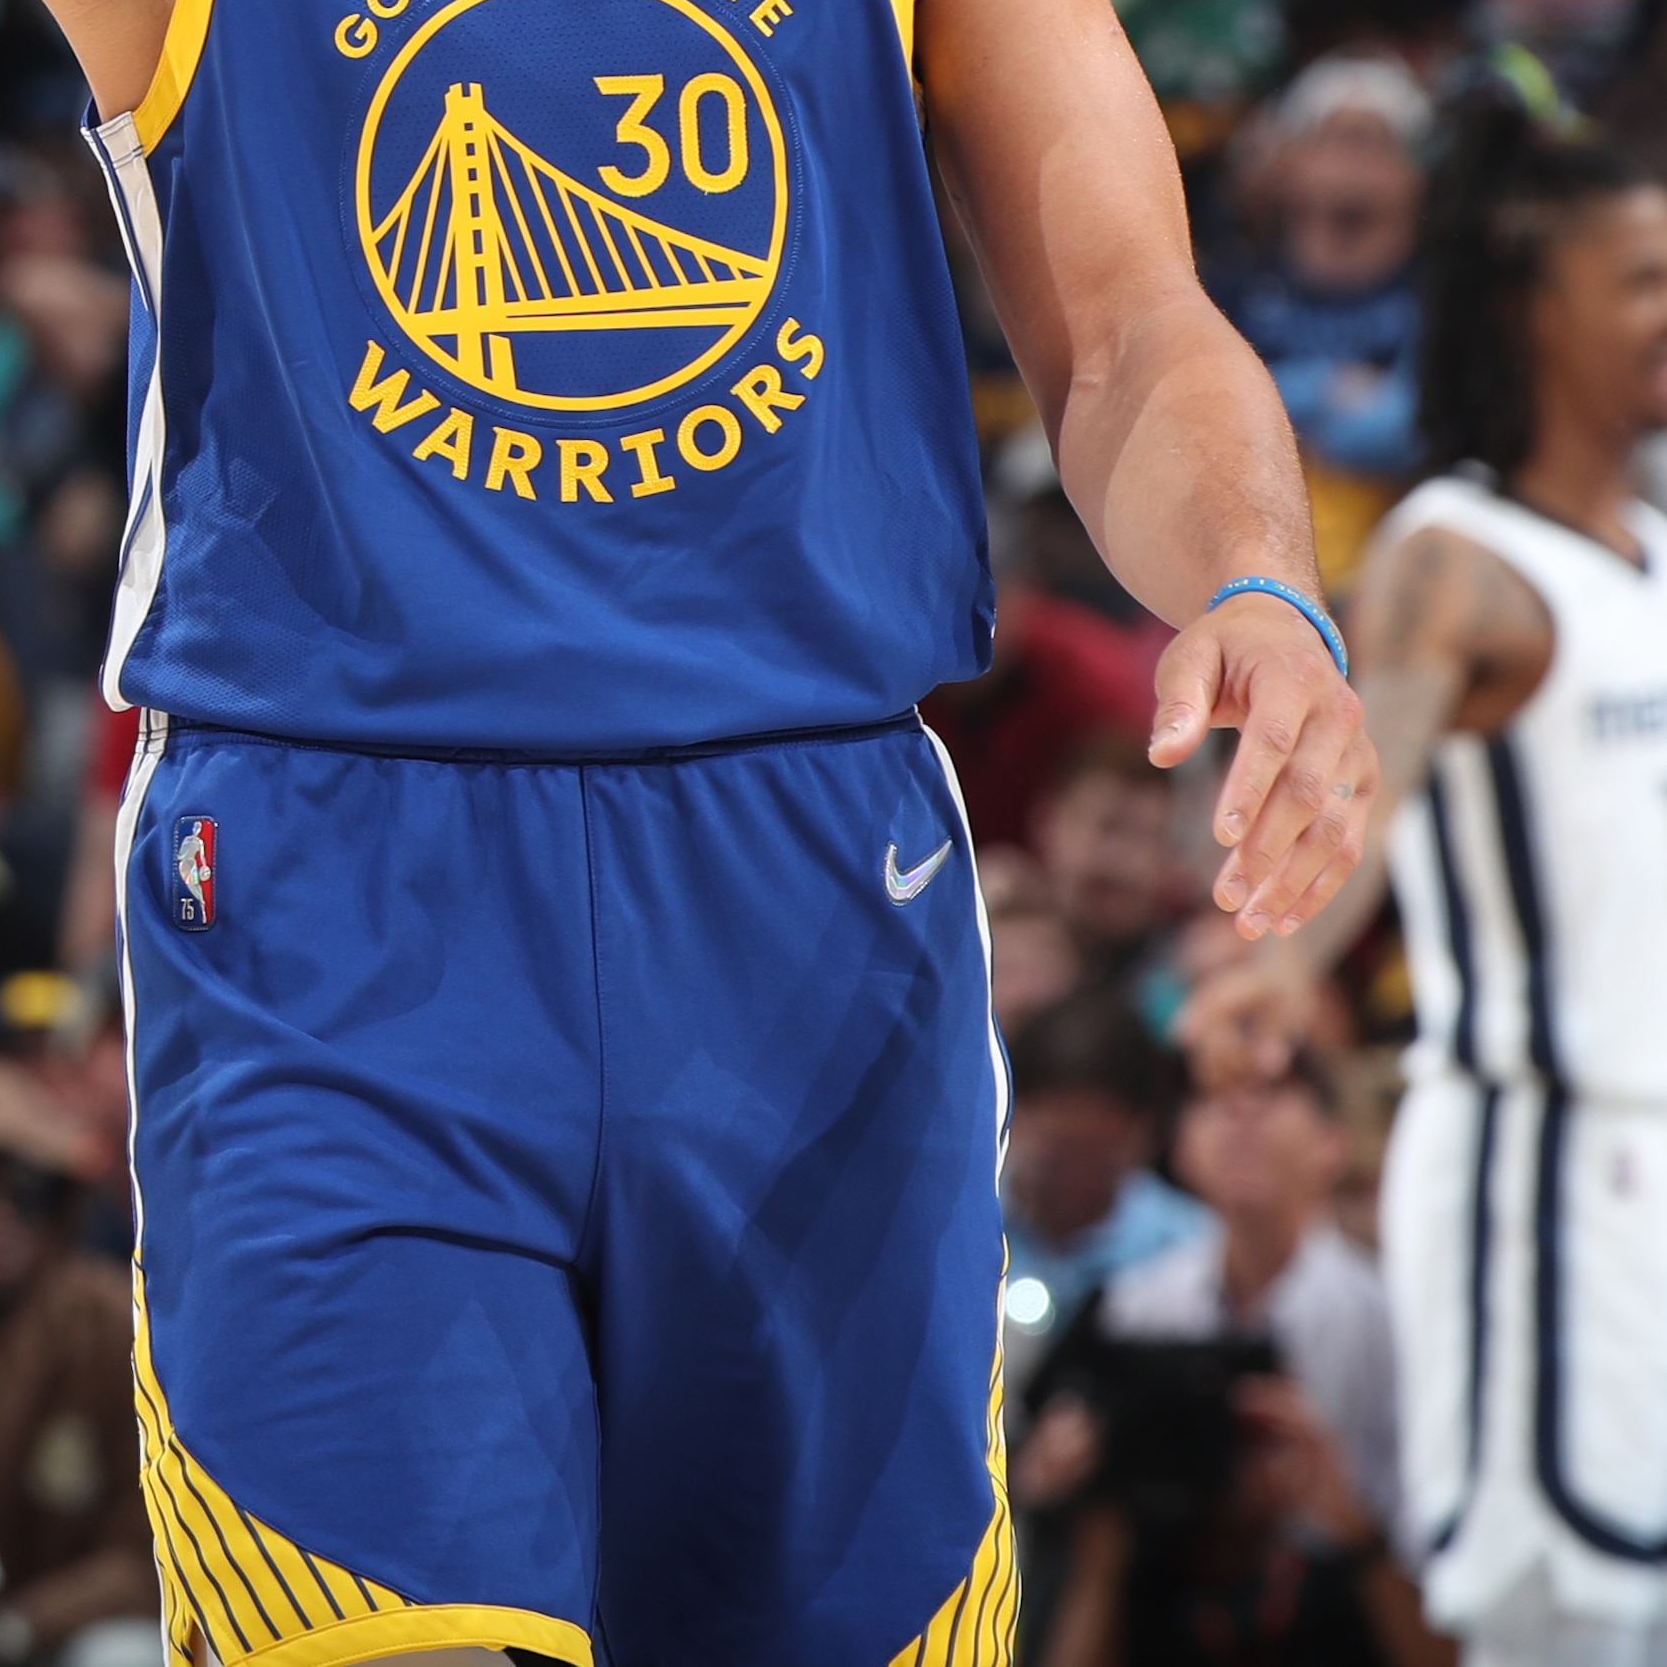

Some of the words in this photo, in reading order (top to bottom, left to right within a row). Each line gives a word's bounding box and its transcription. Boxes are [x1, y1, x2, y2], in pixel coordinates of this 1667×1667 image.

[594, 74, 748, 197] 30
[348, 318, 824, 505] WARRIORS
[181, 898, 195, 920] 75
